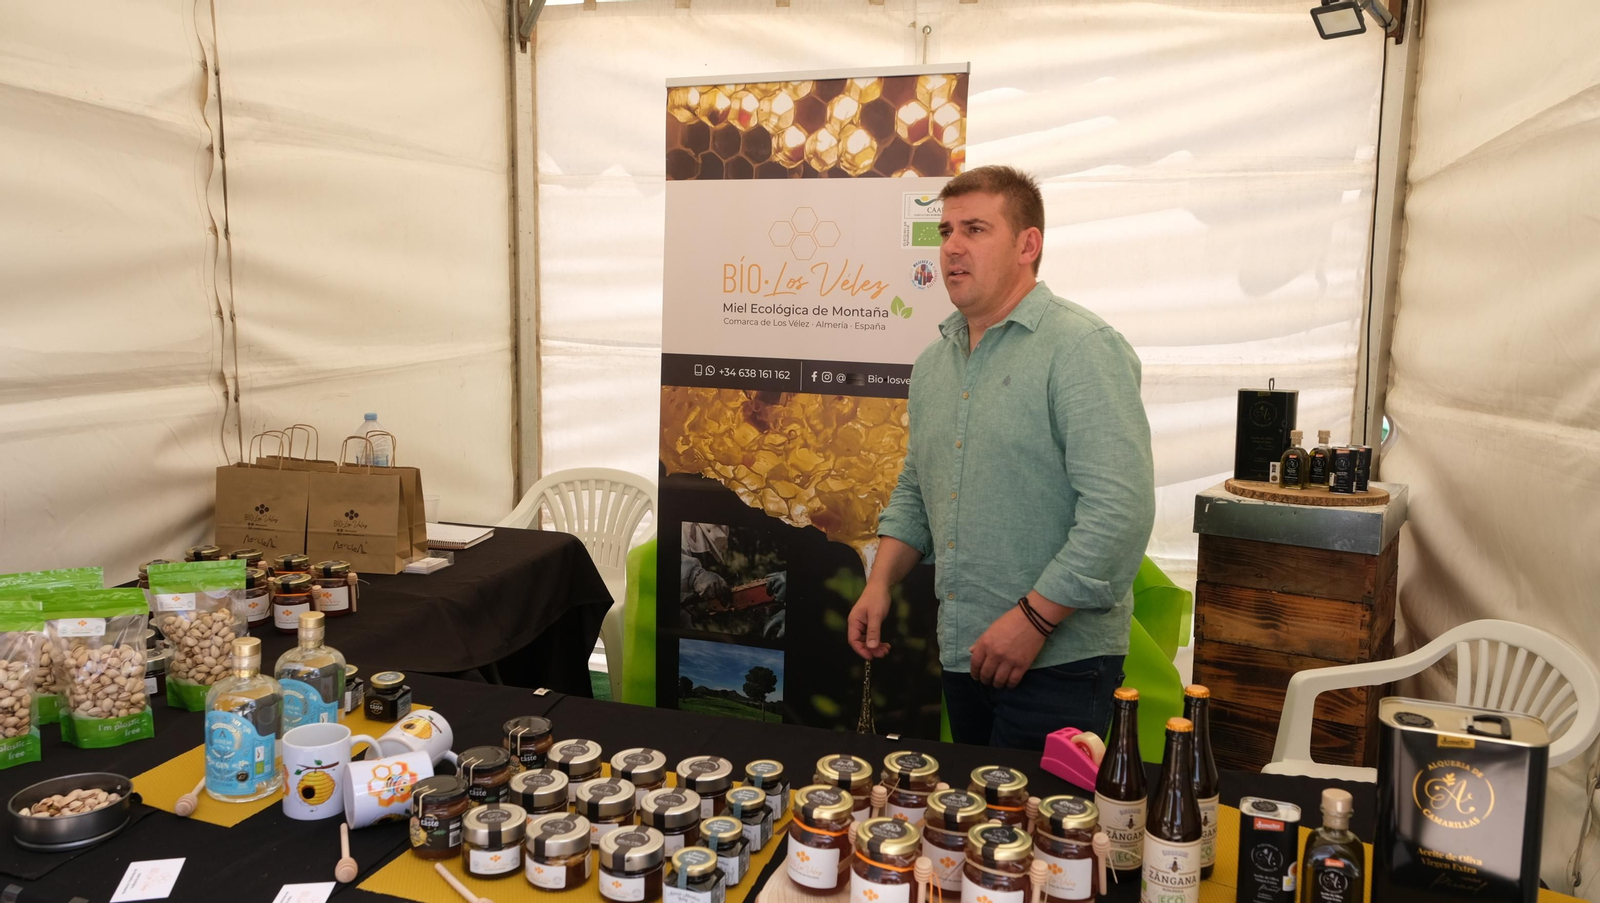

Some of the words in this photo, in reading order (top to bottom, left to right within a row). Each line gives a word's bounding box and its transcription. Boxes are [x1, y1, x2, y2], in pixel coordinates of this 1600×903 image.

[810, 258, 889, 300] Vélez
[723, 302, 746, 314] Miel
[750, 304, 808, 318] Ecológica
[812, 305, 828, 316] de
[832, 306, 889, 318] Montaña
[724, 318, 758, 326] Comarca
[788, 319, 810, 328] Vélez
[816, 320, 848, 329] Almería
[854, 321, 886, 331] España
[719, 367, 736, 377] +34
[738, 368, 756, 378] 638
[759, 369, 772, 379] 161
[774, 370, 791, 380] 162
[114, 719, 140, 731] plastic
[125, 727, 140, 736] free
[1442, 737, 1471, 746] demeter
[9, 750, 25, 760] free
[1471, 768, 1484, 778] DE
[1256, 821, 1280, 829] demeter
[1423, 808, 1480, 829] CAMARILLAS
[1106, 830, 1145, 840] ZÁNGAN
[1418, 847, 1445, 859] Aceite
[1445, 852, 1457, 861] de
[1458, 855, 1482, 866] Oliva
[1421, 857, 1451, 870] Virgen
[1452, 862, 1477, 875] Extra
[1149, 869, 1197, 886] ZÁNGANA
